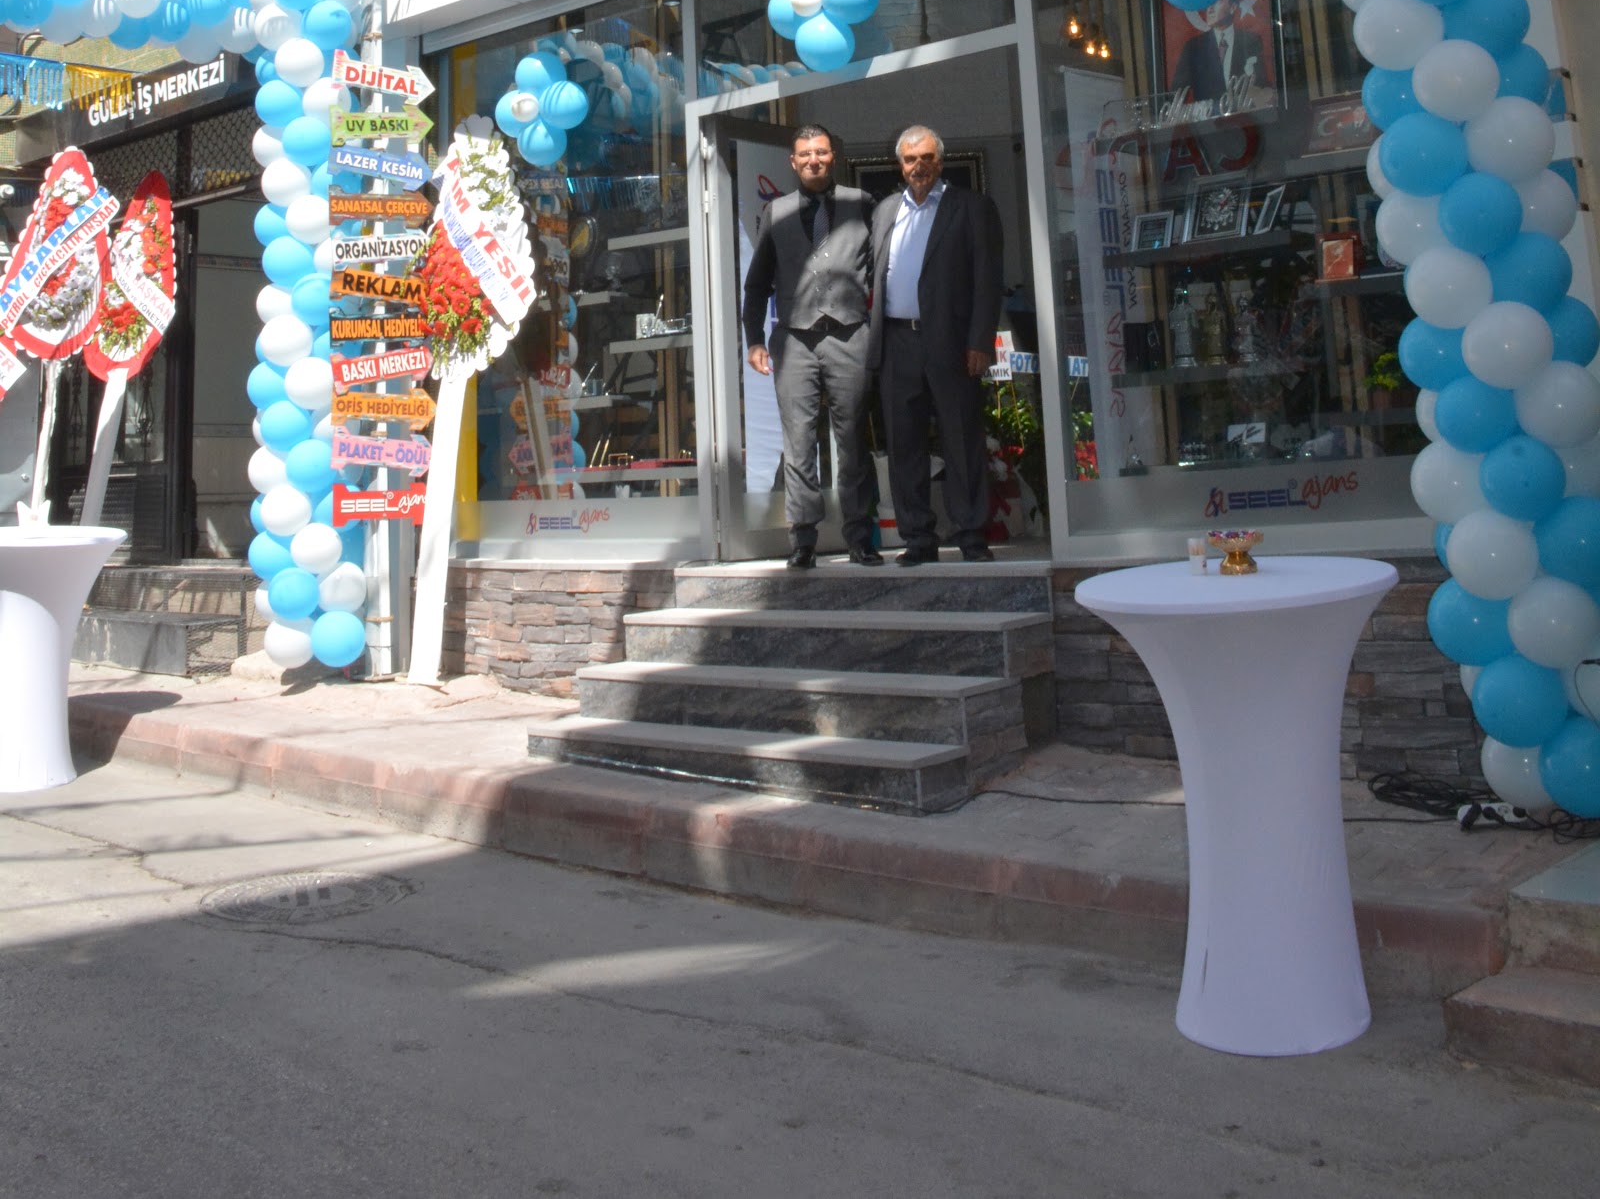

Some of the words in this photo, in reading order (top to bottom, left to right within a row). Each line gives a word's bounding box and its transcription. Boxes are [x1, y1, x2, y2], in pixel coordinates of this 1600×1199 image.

[137, 82, 153, 115] İŞ
[154, 54, 225, 105] MERKEZİ
[344, 64, 419, 96] DİJİTAL
[346, 119, 366, 133] UV
[370, 119, 409, 133] BASKI
[335, 151, 378, 171] LAZER
[381, 159, 424, 180] KESİM
[330, 199, 384, 214] SANATSAL
[386, 201, 428, 219] ÇERÇEVE
[335, 236, 428, 261] ORGANİZASYON
[342, 272, 421, 301] REKLAM
[331, 318, 383, 340] KURUMSAL
[341, 362, 376, 383] BASKI
[379, 346, 427, 376] MERKEZİ
[336, 398, 363, 414] OFİS
[366, 399, 429, 417] HEDİYELİĞİ
[338, 441, 384, 461] PLAKET
[395, 442, 429, 465] ÖDÜL
[1227, 488, 1306, 510] SEEL
[1302, 470, 1359, 510] ajans
[340, 497, 400, 514] SEEL
[539, 516, 582, 530] SEEL
